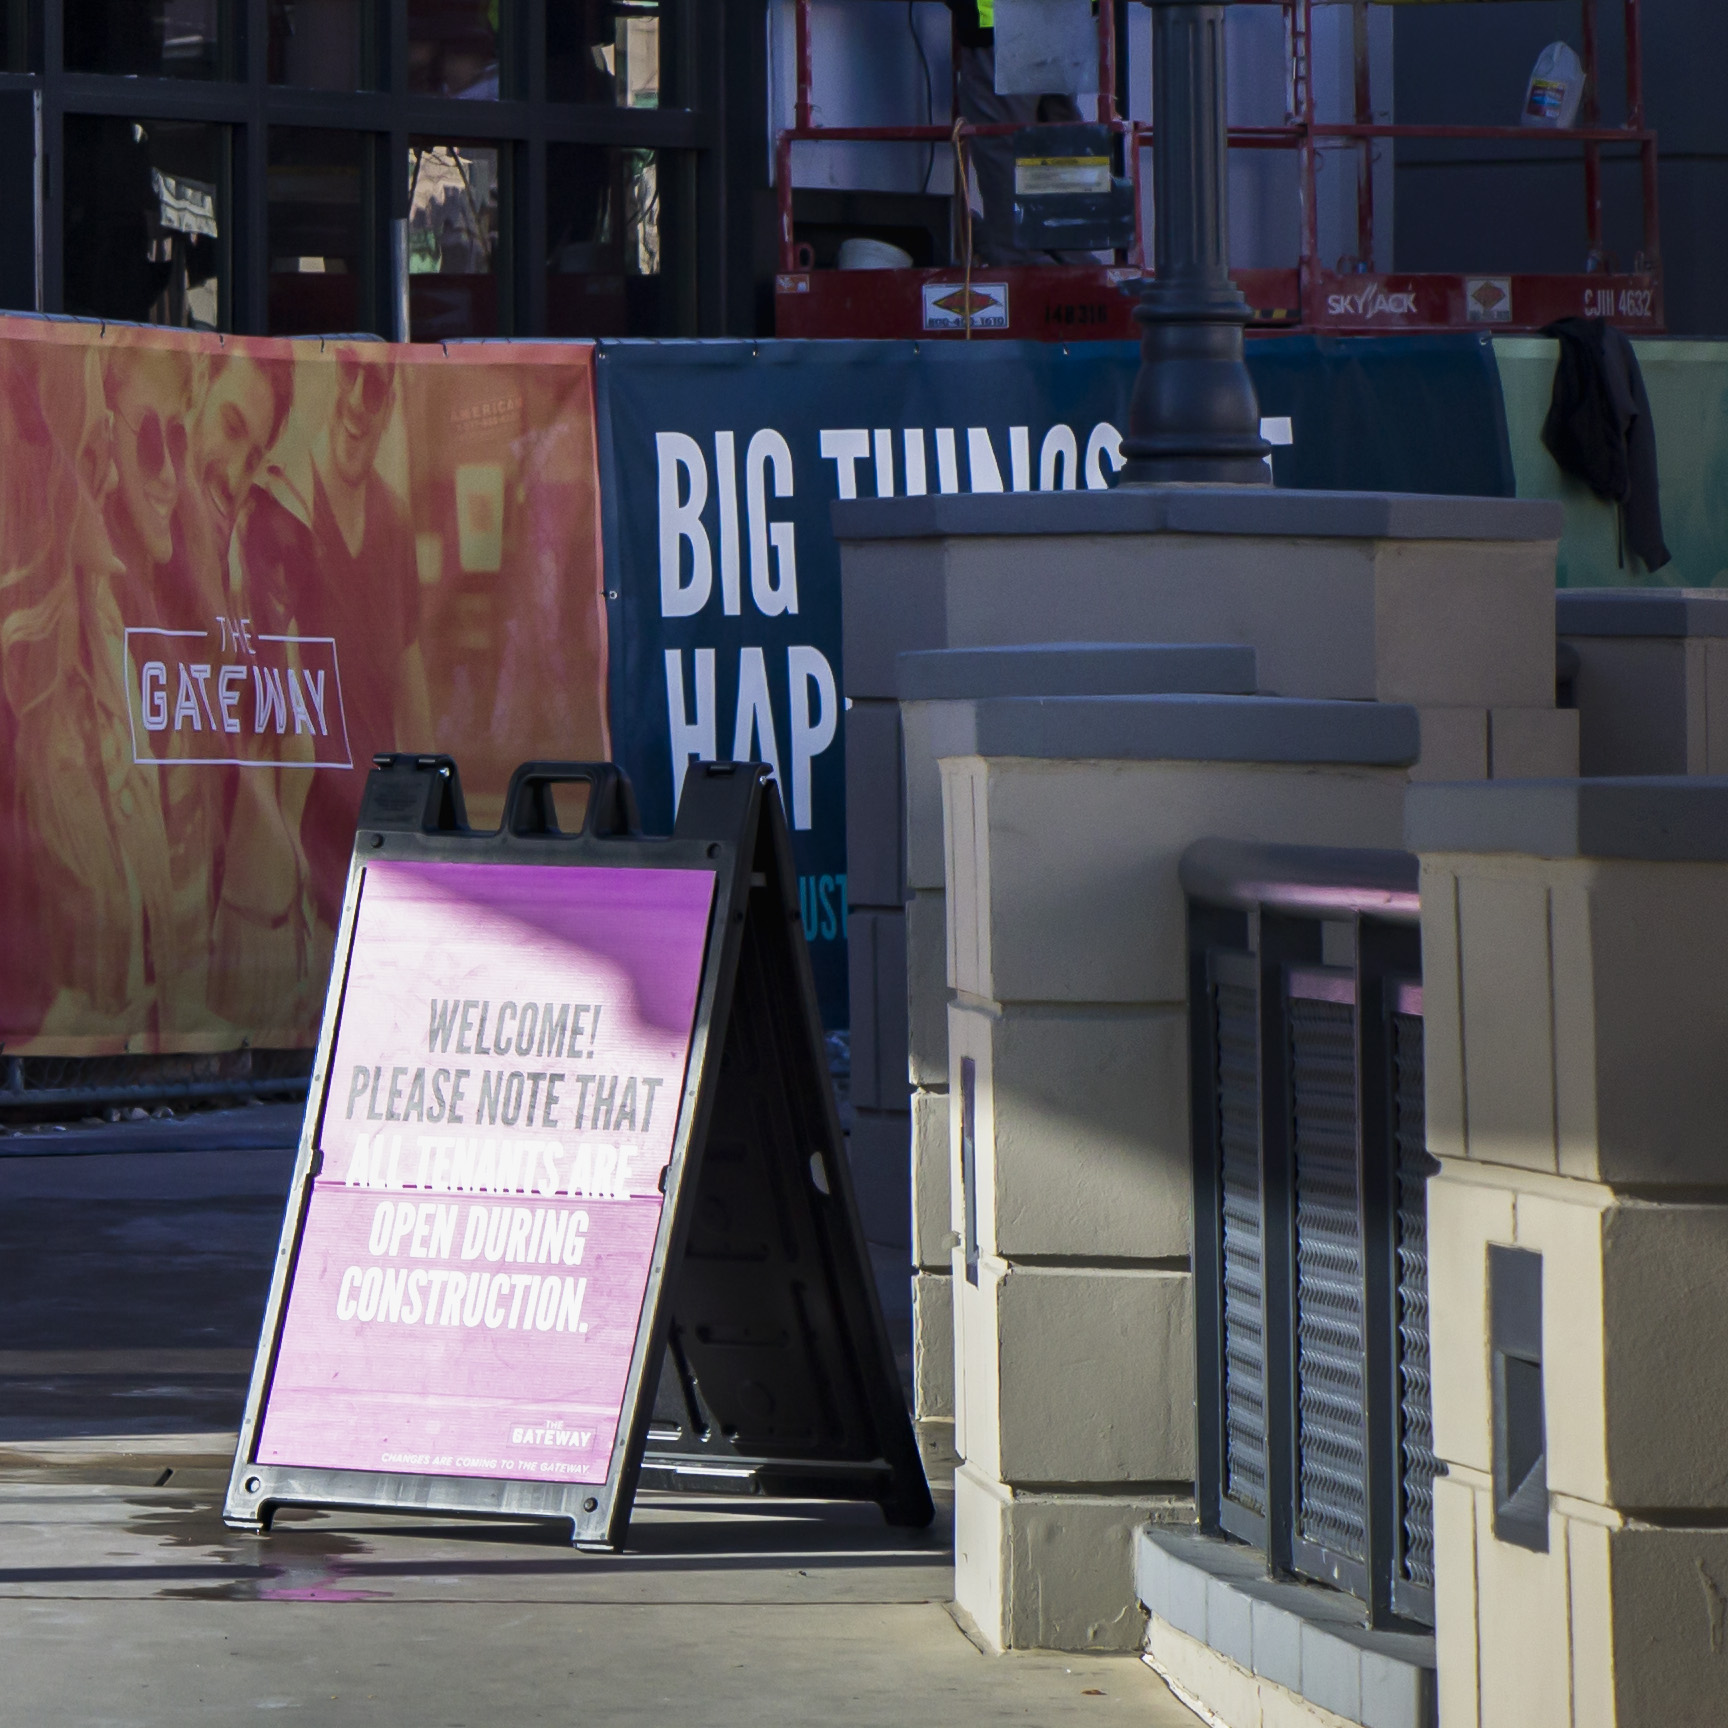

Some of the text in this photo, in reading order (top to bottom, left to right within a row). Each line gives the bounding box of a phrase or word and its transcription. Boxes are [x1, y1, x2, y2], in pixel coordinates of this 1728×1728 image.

[1328, 282, 1417, 319] SKYJACK
[1619, 289, 1652, 316] 4632
[655, 428, 799, 618] BIG
[216, 616, 258, 656] THE
[142, 661, 329, 736] GATEWAY
[800, 873, 848, 941] UST
[429, 999, 602, 1059] WELCOME!
[345, 1065, 663, 1132] PLEASE NOTE THAT
[345, 1133, 638, 1201] ALL TENANTS ARE
[368, 1200, 589, 1265] OPEN DURING
[336, 1265, 589, 1333] CONSTRUCTION.
[512, 1428, 592, 1447] GATEWAY
[545, 1420, 564, 1429] THE
[381, 1453, 430, 1465] CHANGES
[432, 1456, 453, 1466] ARE
[455, 1457, 497, 1469] COMING
[500, 1460, 515, 1470] TO
[517, 1461, 538, 1472] THE
